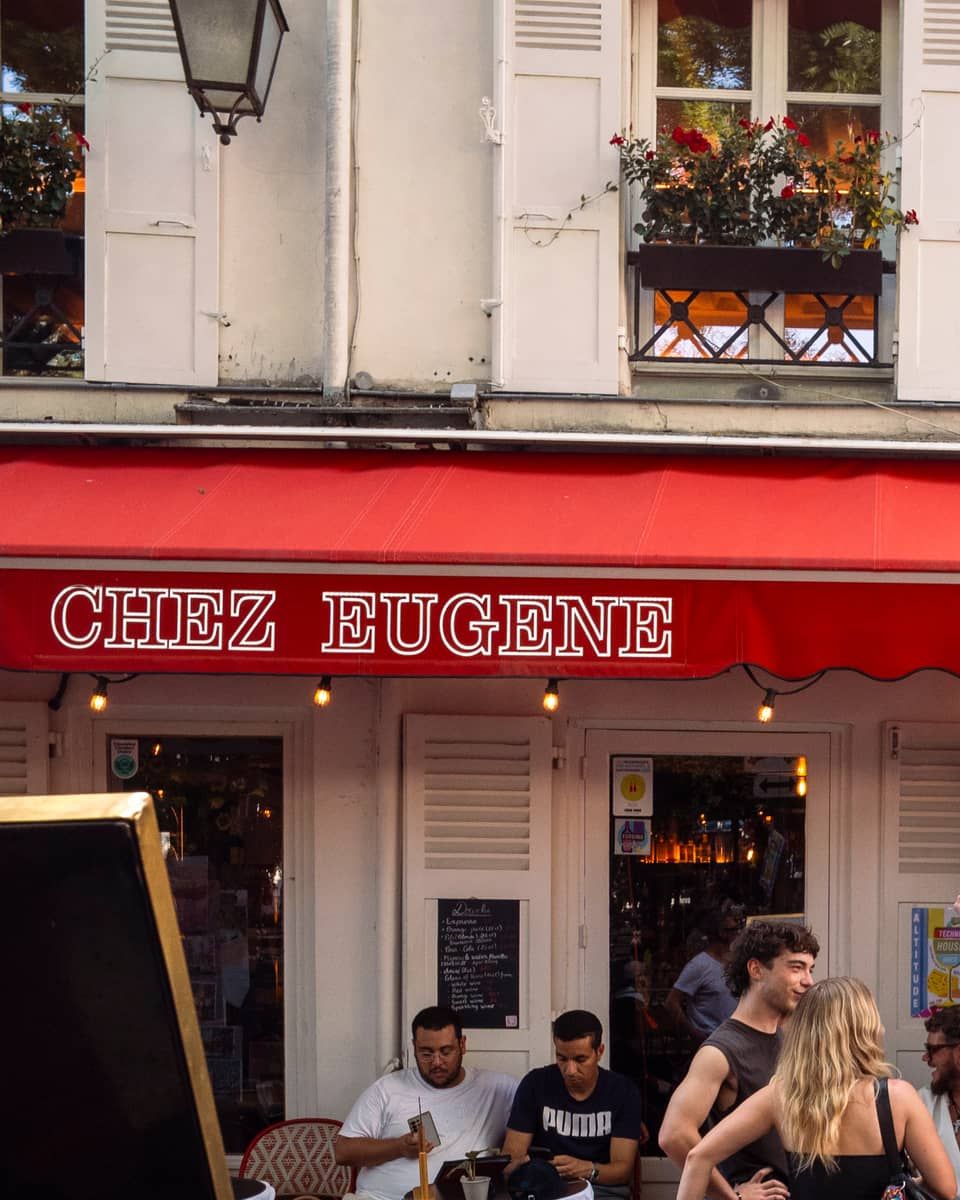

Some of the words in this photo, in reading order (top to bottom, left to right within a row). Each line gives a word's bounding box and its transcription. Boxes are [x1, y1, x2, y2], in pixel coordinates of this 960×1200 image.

[51, 584, 276, 651] CHEZ
[321, 591, 673, 658] EUGENE
[912, 912, 920, 1008] ALTITUDE
[543, 1105, 612, 1137] PUMA
